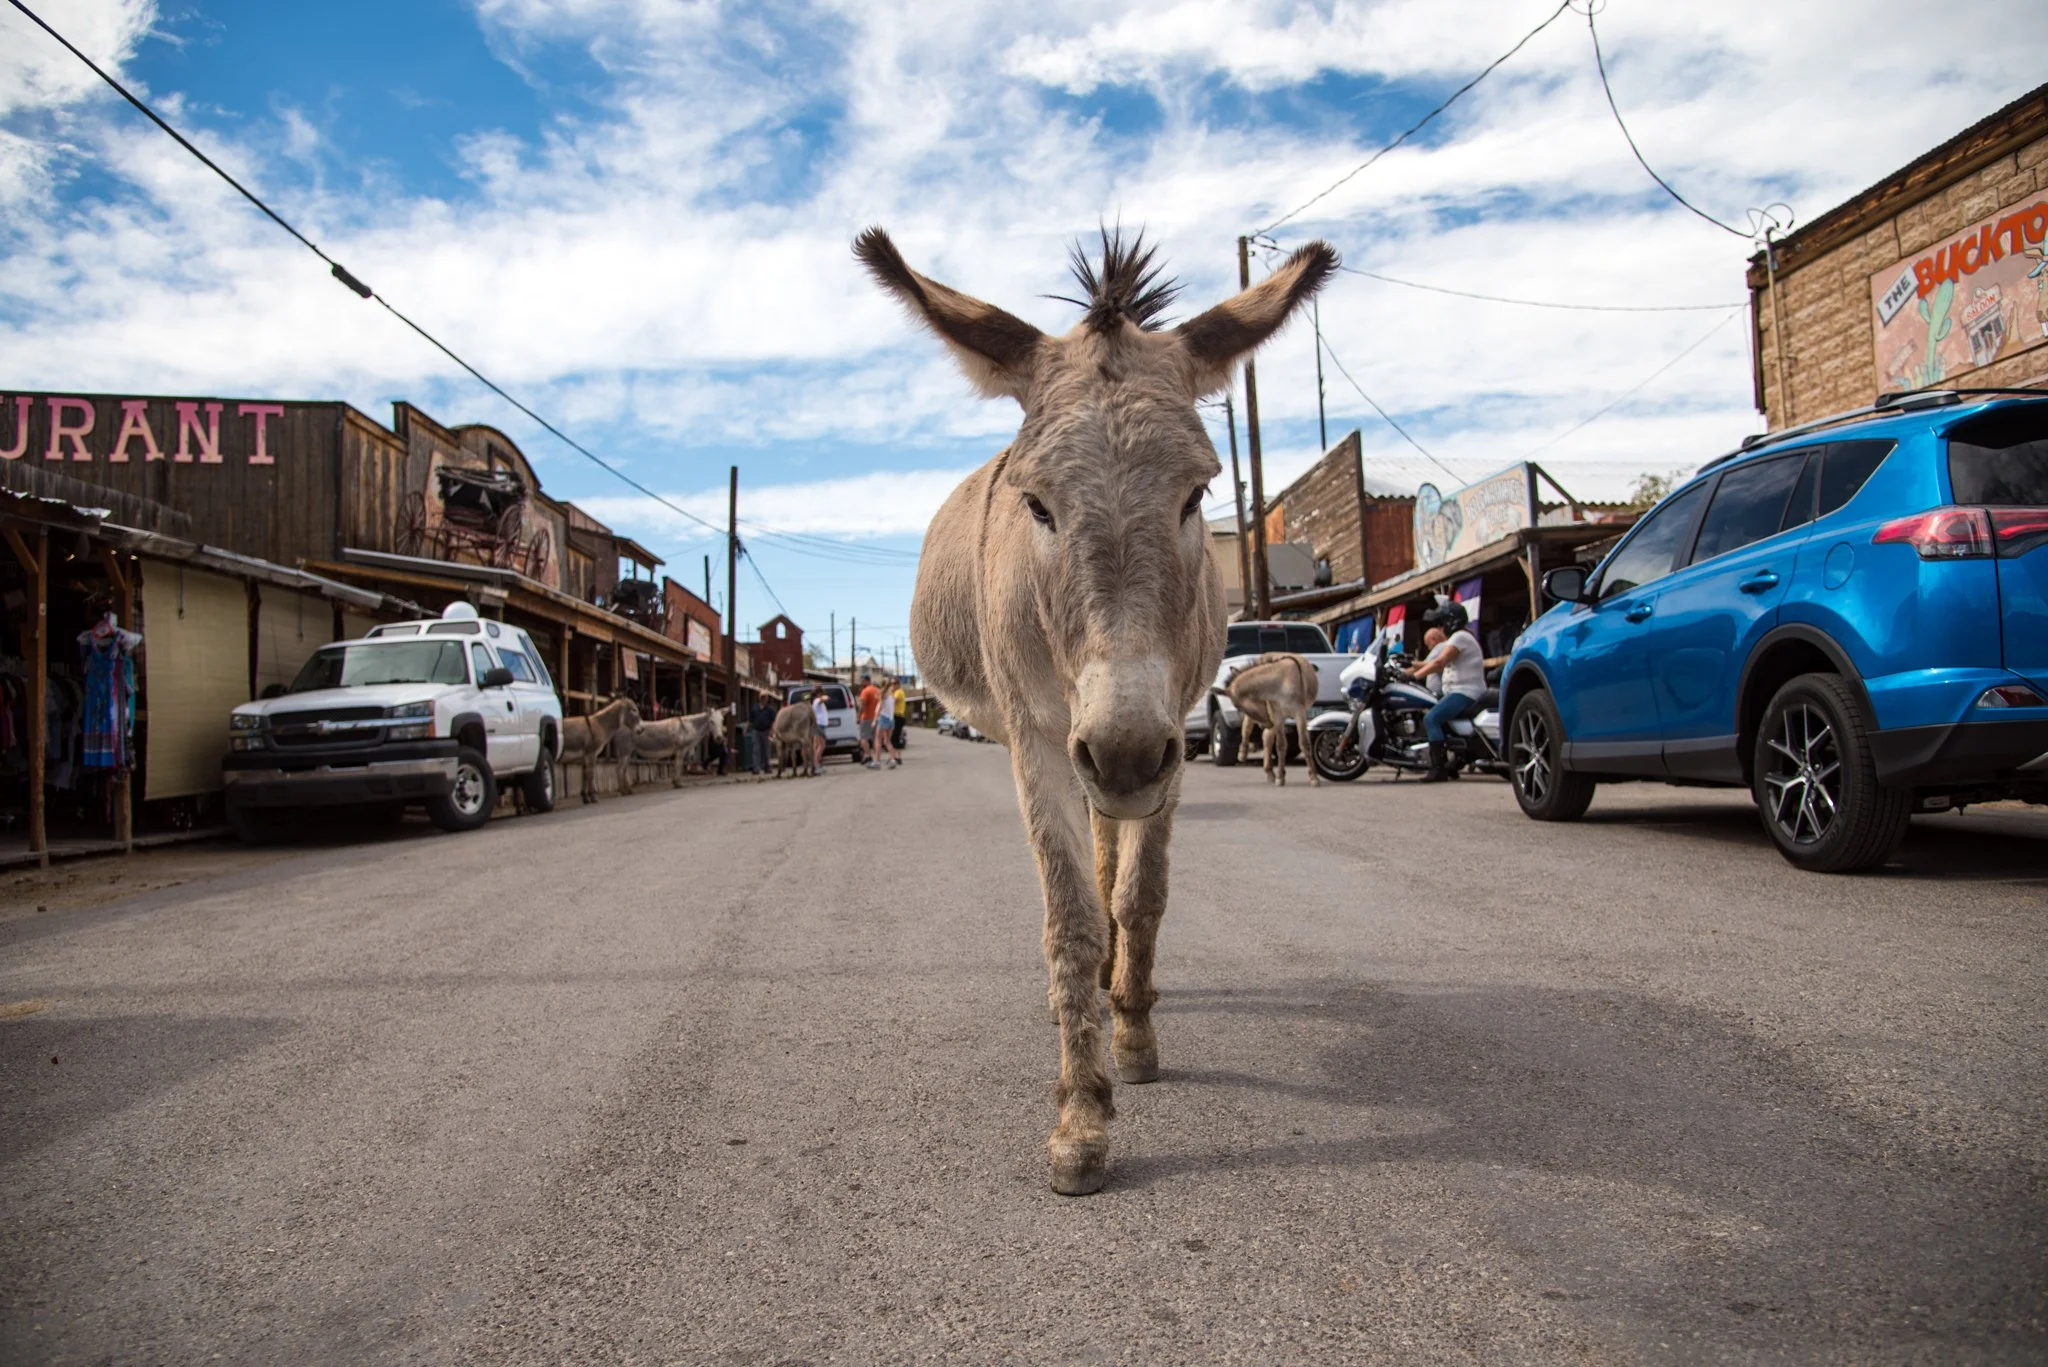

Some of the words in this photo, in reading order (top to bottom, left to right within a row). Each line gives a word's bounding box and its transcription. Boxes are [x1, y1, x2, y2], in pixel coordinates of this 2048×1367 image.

[1884, 275, 1911, 310] THE
[1914, 201, 2048, 299] BUCKTO
[1967, 294, 1996, 320] SALOON
